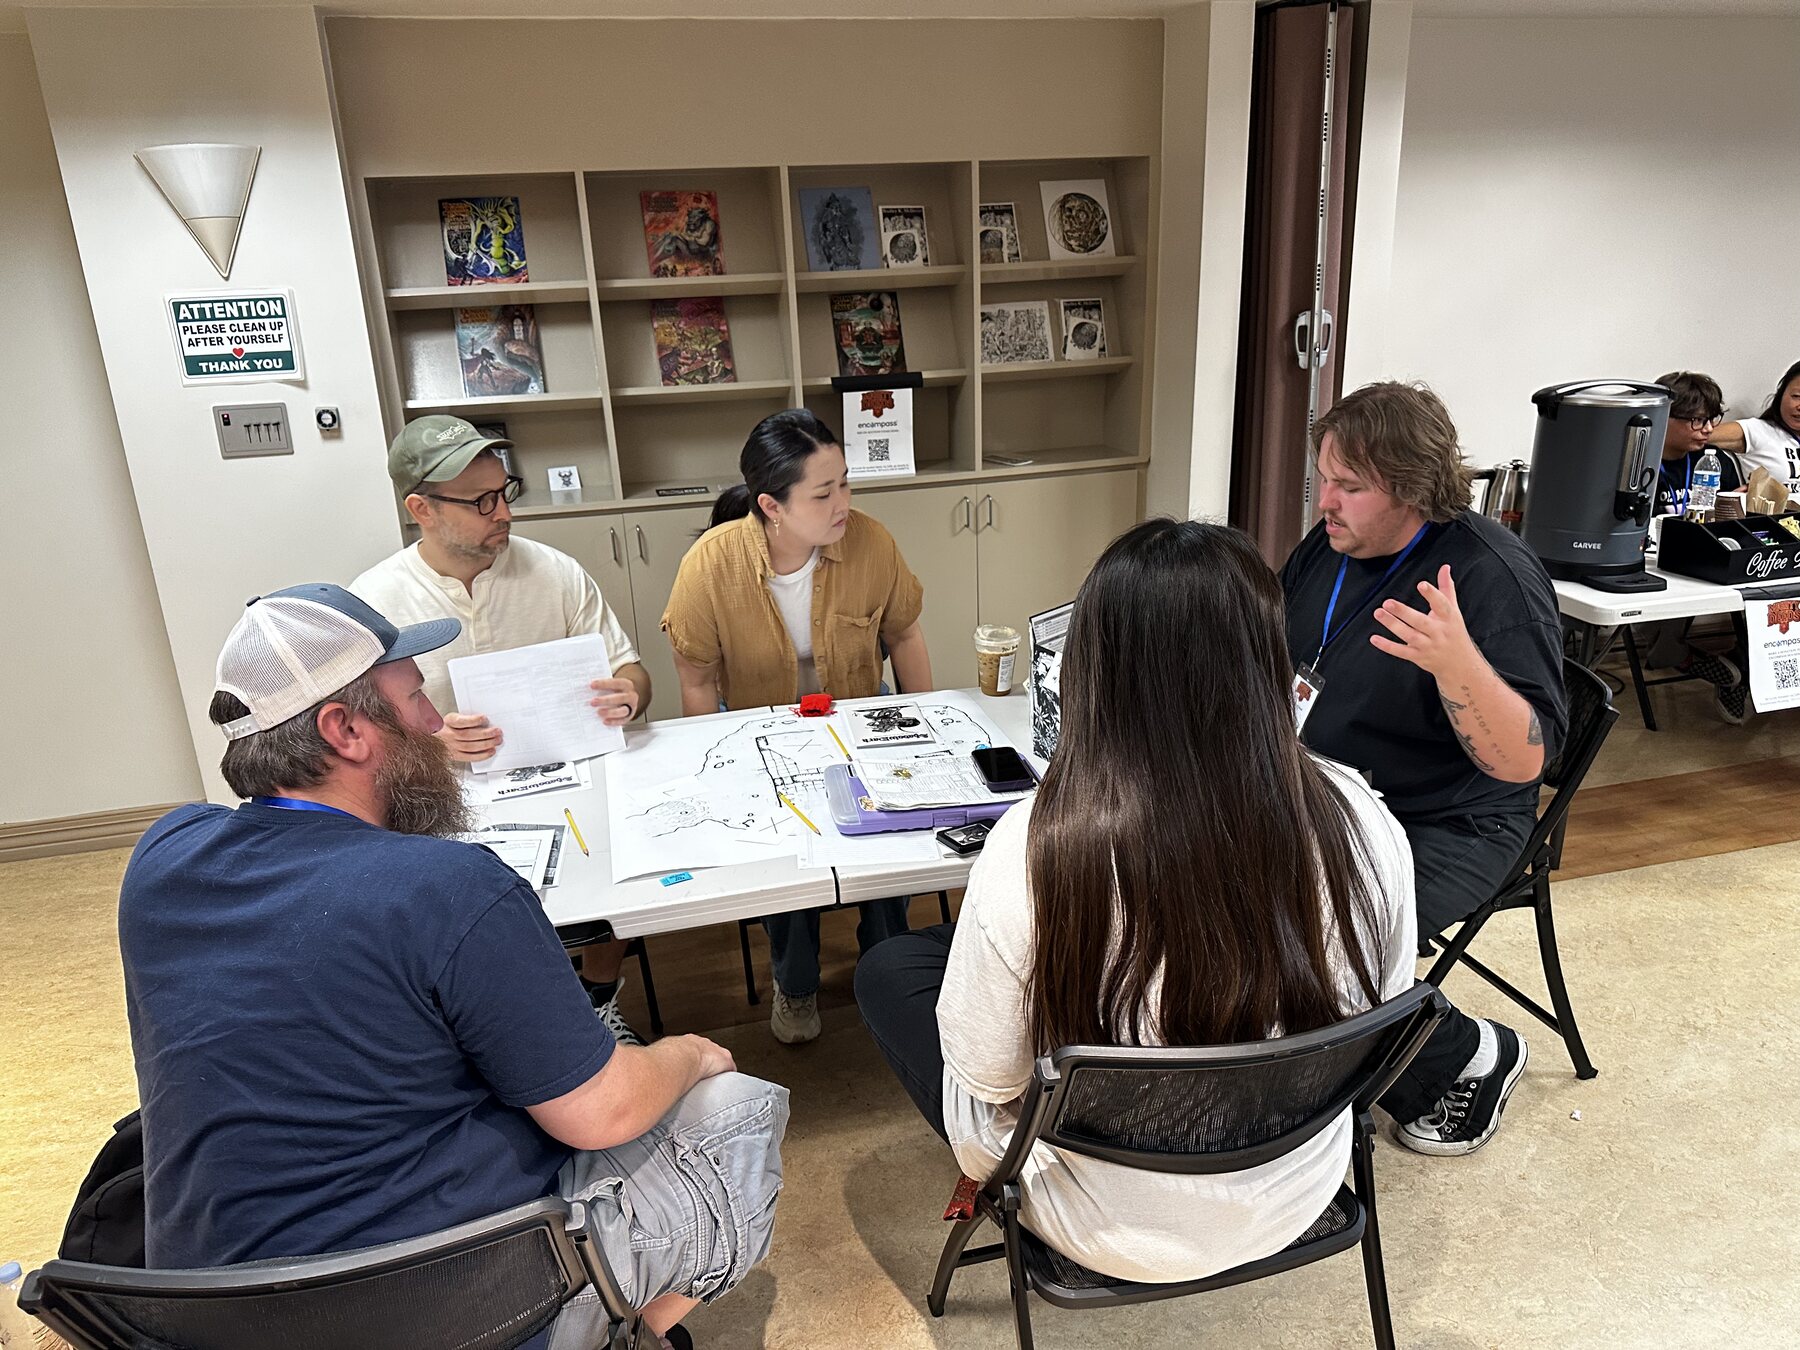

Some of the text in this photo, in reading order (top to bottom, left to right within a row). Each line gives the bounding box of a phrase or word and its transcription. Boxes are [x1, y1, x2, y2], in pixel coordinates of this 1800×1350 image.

[178, 300, 283, 320] ATTENTION
[182, 321, 284, 335] PLEASE CLEAN UP
[187, 333, 284, 348] AFTER YOURSELF
[198, 358, 283, 373] THANK YOU
[1572, 541, 1602, 550] GARVEE
[1746, 549, 1788, 578] Coffee
